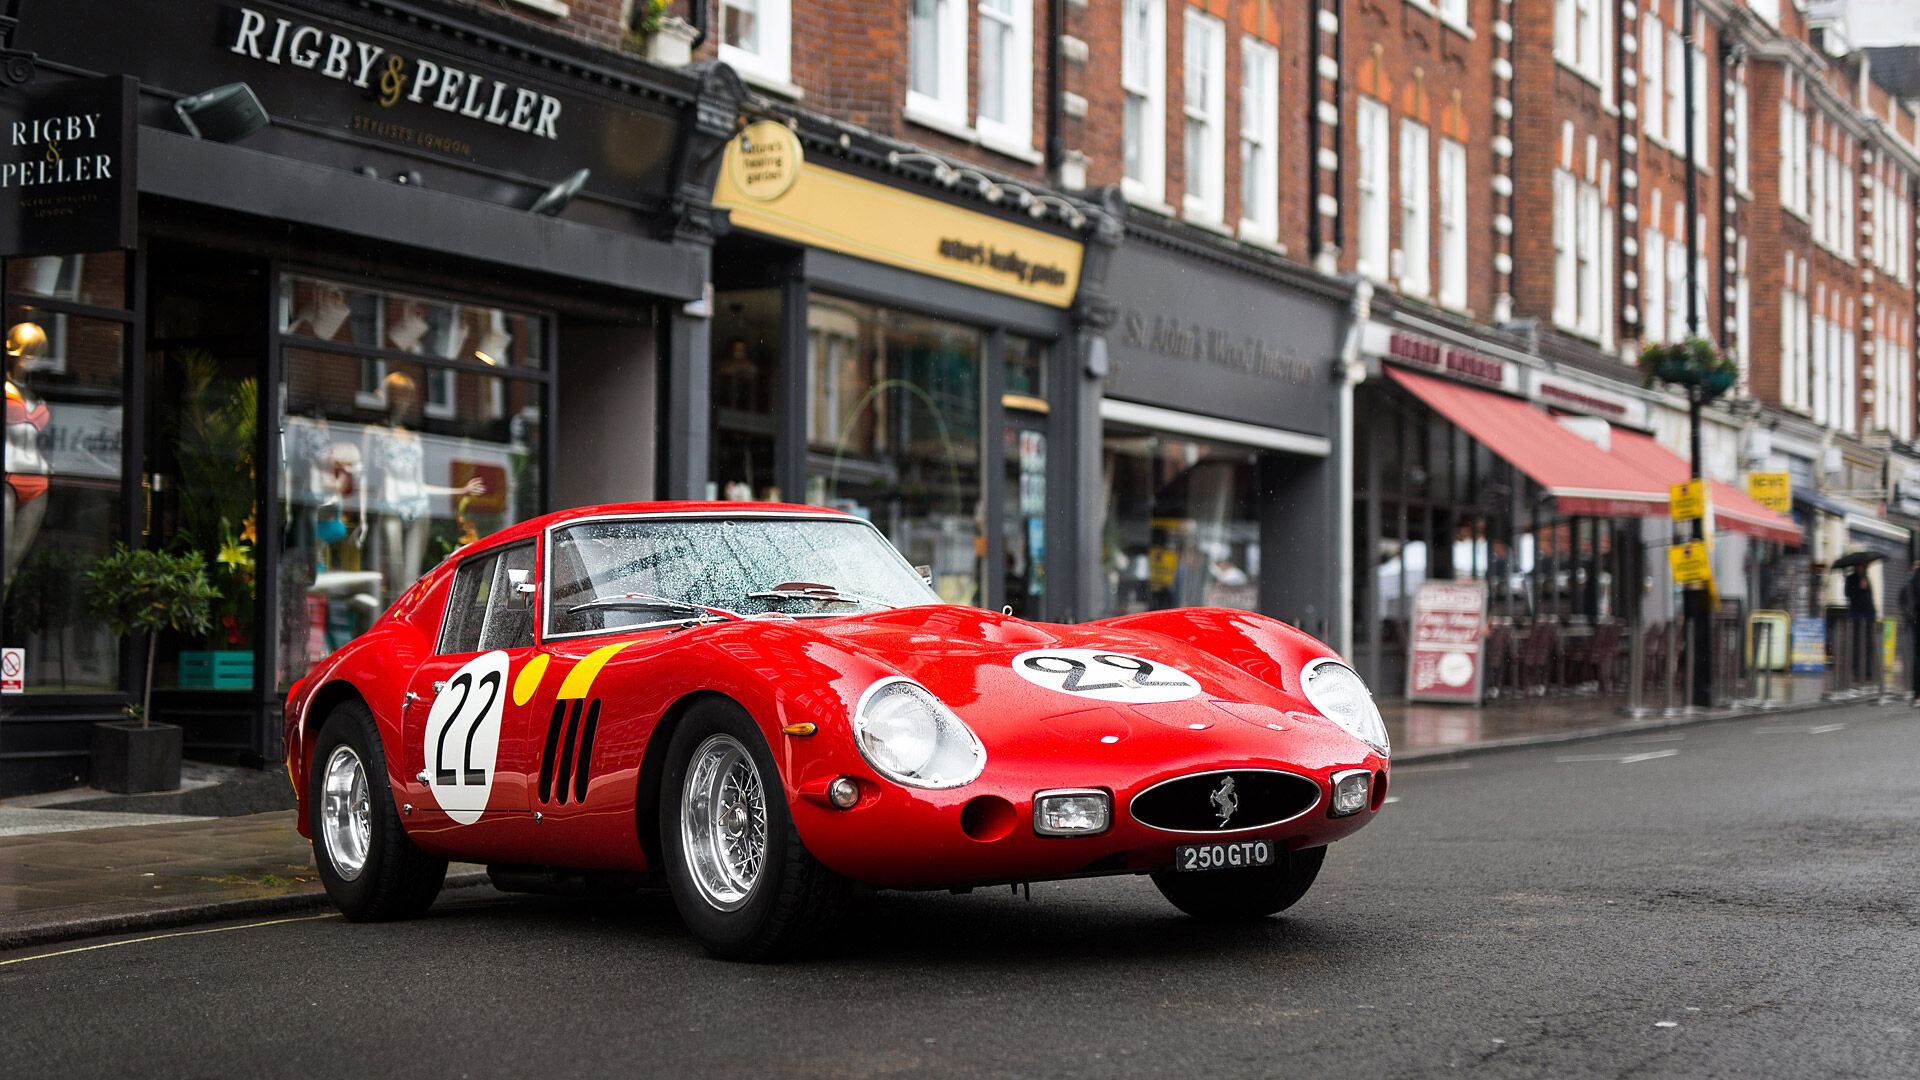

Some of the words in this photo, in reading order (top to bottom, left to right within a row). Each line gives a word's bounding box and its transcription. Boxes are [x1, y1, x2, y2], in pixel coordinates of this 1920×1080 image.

[231, 8, 384, 88] RIGBY
[379, 54, 408, 108] &
[407, 58, 562, 140] PELLER
[11, 113, 101, 146] RIGBY
[352, 115, 415, 144] STYLISTS
[416, 131, 471, 157] LONDON
[2, 154, 113, 188] PELLER
[1024, 655, 1191, 692] 22
[435, 670, 502, 786] 22
